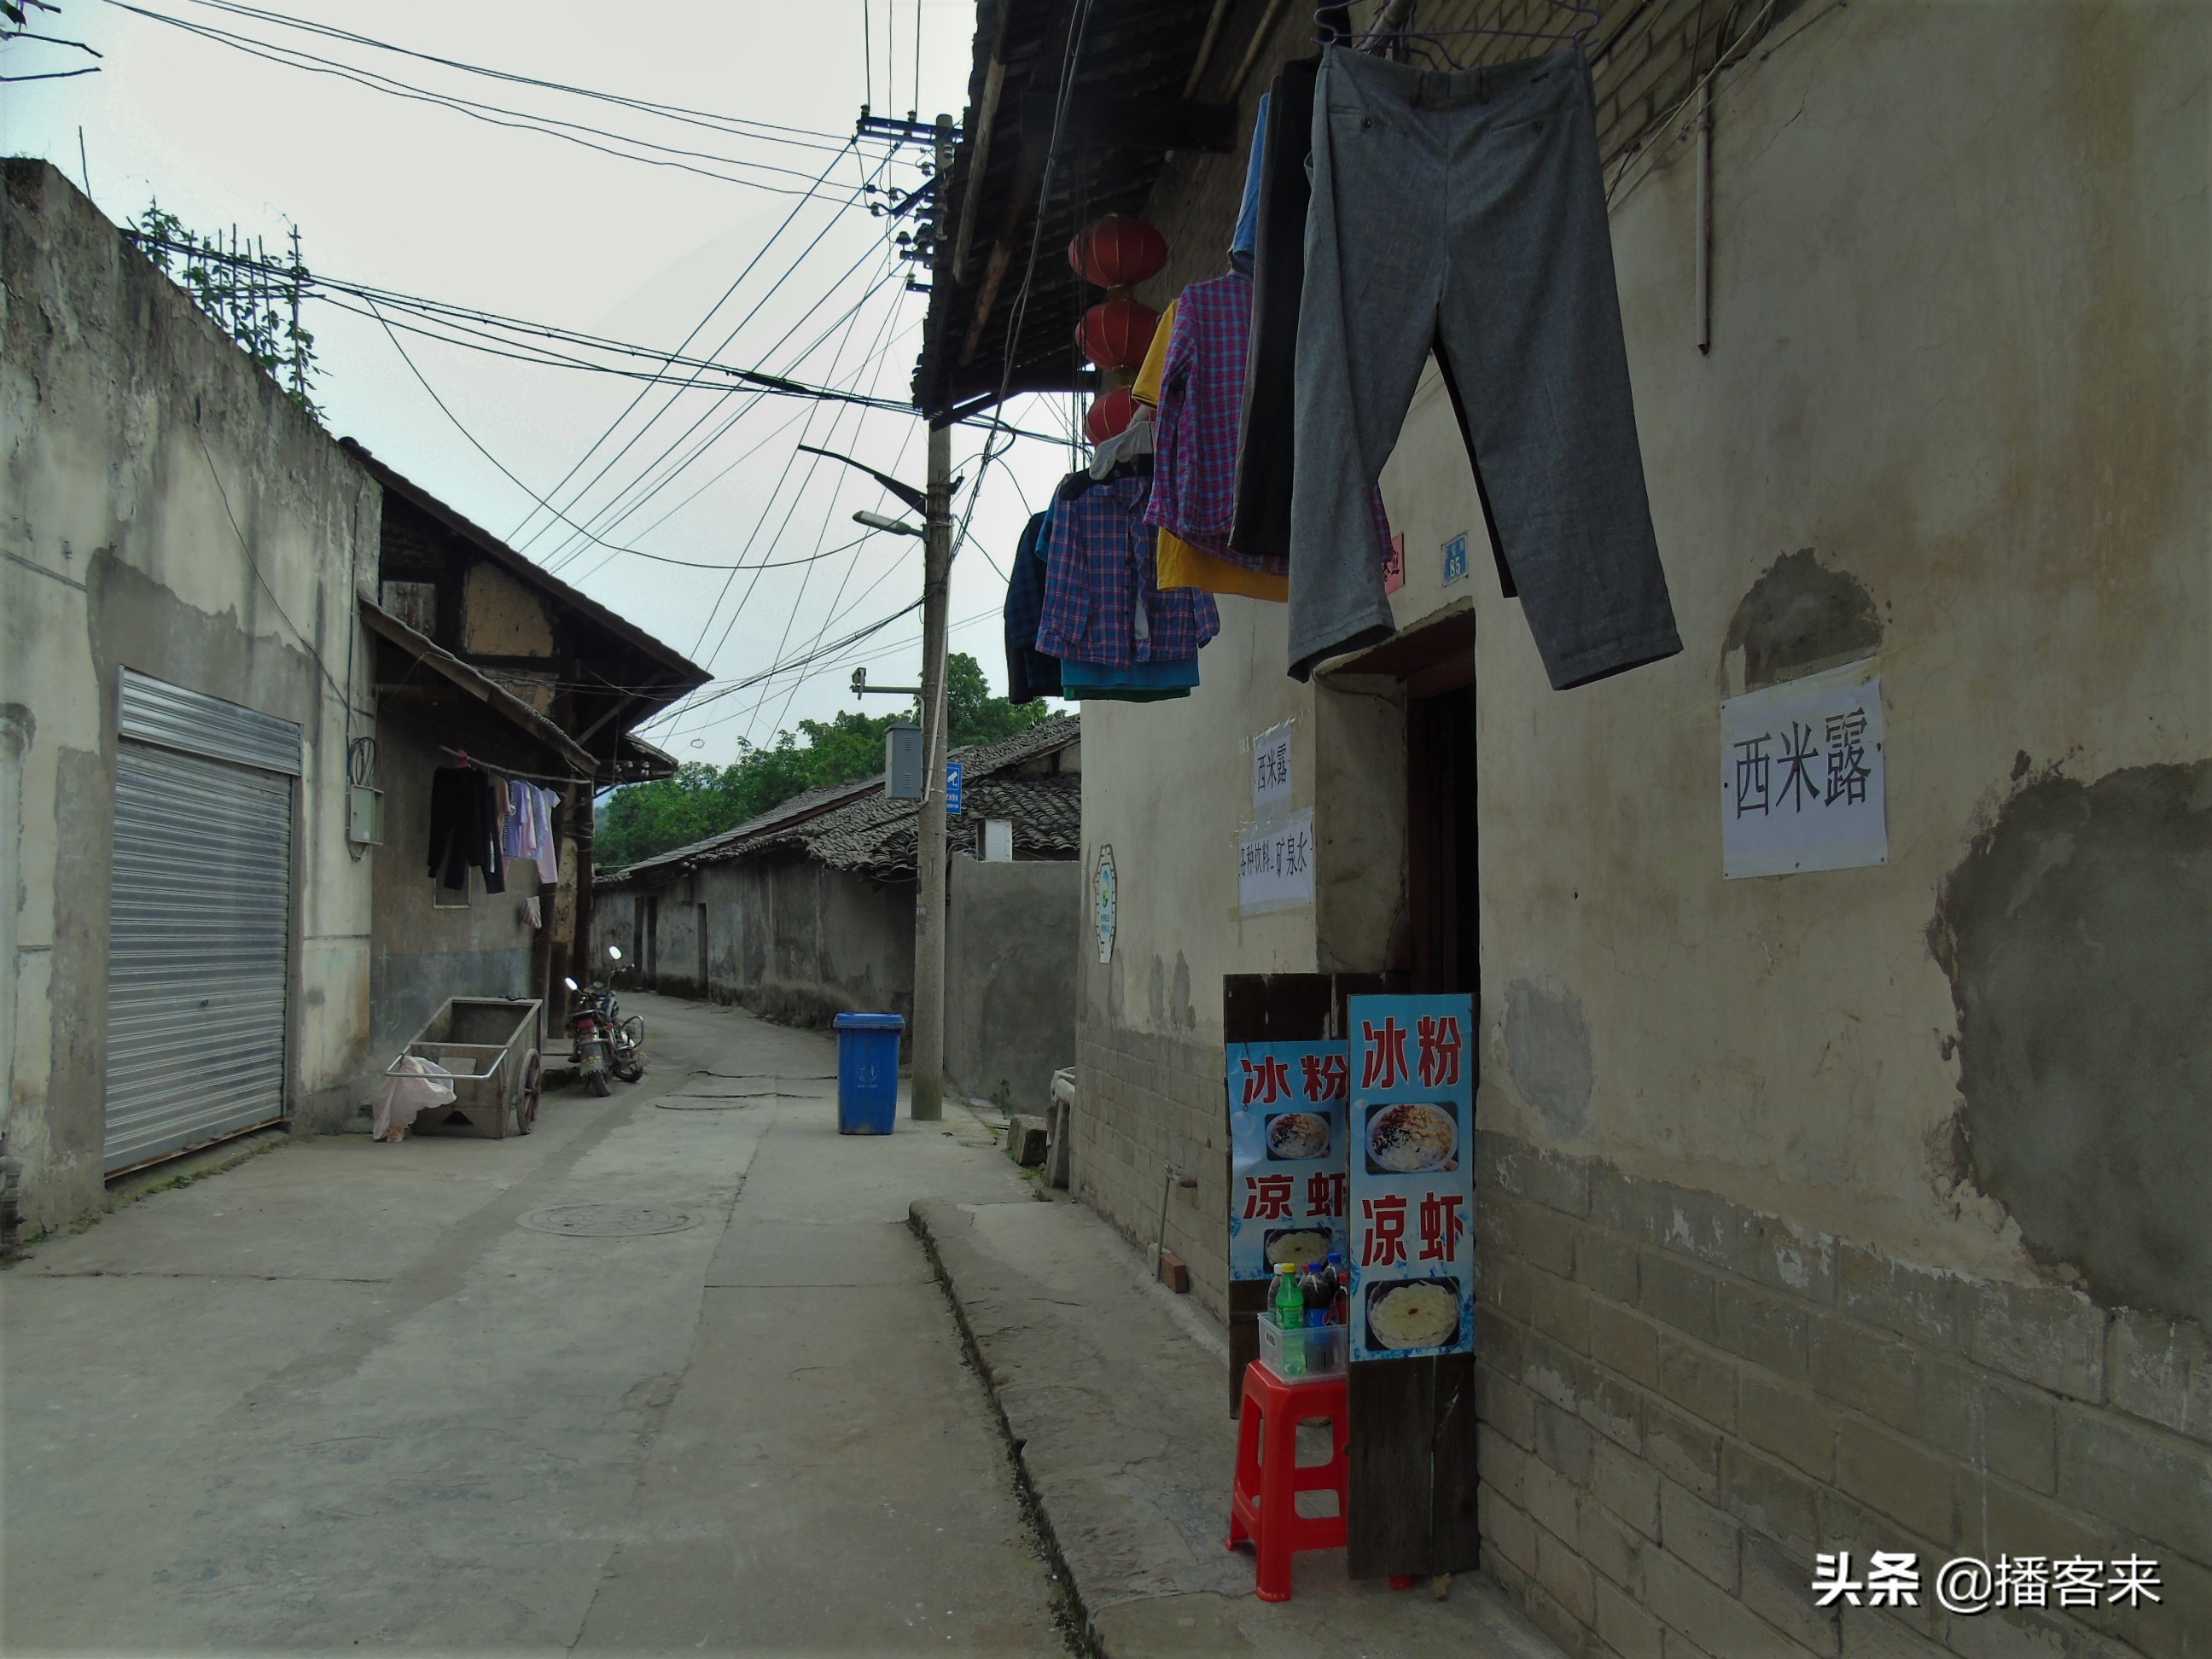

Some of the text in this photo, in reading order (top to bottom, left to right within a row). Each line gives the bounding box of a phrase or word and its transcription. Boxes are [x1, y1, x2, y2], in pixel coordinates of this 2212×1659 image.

[1449, 556, 1460, 577] 85
[1257, 742, 1287, 792] 西米露
[1734, 707, 1871, 819] 西米露
[1362, 1016, 1463, 1089] 冰粉
[1241, 1055, 1347, 1103] 冰粉
[1244, 1172, 1346, 1219] 凉虾
[1362, 1192, 1464, 1266] 凉虾
